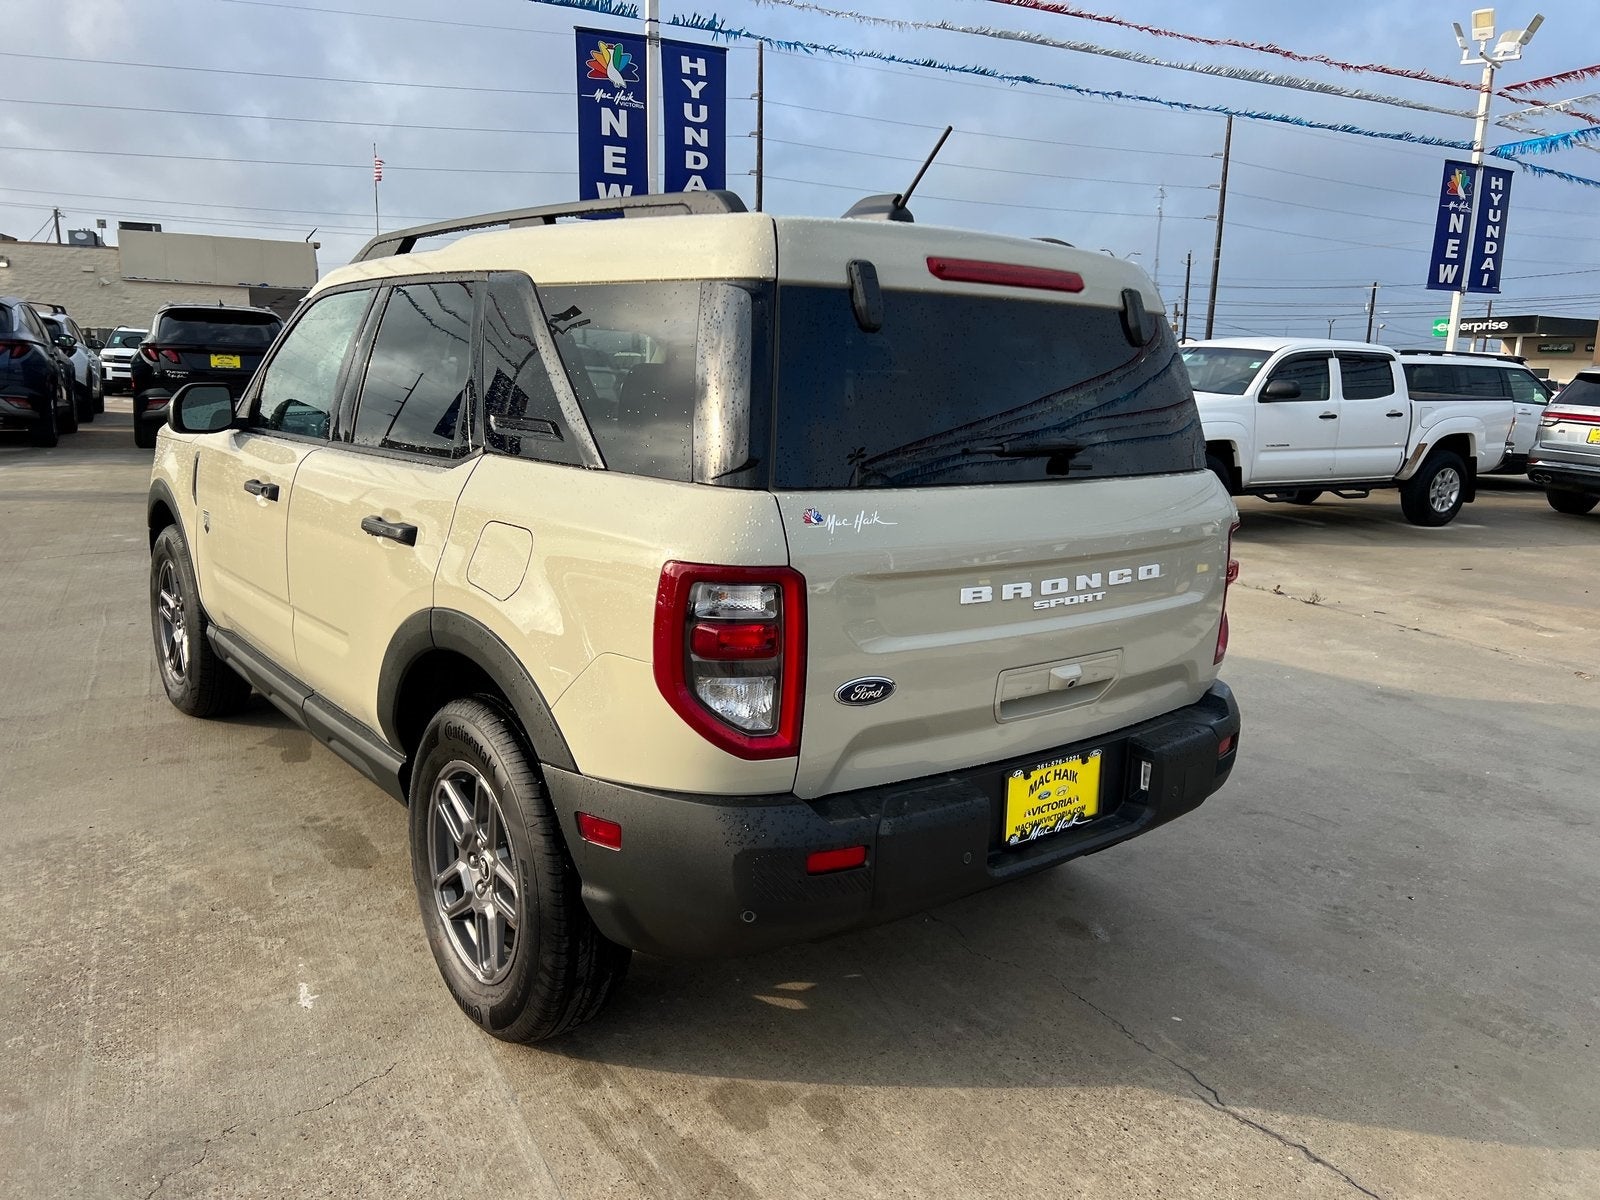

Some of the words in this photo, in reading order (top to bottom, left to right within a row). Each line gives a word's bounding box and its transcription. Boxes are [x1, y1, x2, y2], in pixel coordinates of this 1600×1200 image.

[581, 88, 614, 103] Mac
[614, 89, 644, 105] Haik
[680, 55, 709, 192] HYUNDA
[596, 107, 633, 199] NEW
[1480, 176, 1504, 286] HYUNDAI
[1438, 213, 1465, 284] NEW
[1433, 319, 1509, 333] eerprise
[808, 513, 853, 535] Mac
[854, 509, 898, 534] Haik
[960, 563, 1161, 605] BRONCO
[1033, 591, 1107, 610] SPORT
[850, 683, 884, 701] Ford
[1028, 770, 1052, 797] MAC
[1053, 768, 1079, 784] HAIK
[1031, 797, 1073, 816] VICTORIA
[1018, 824, 1054, 843] Mac
[1054, 813, 1093, 832] Haik
